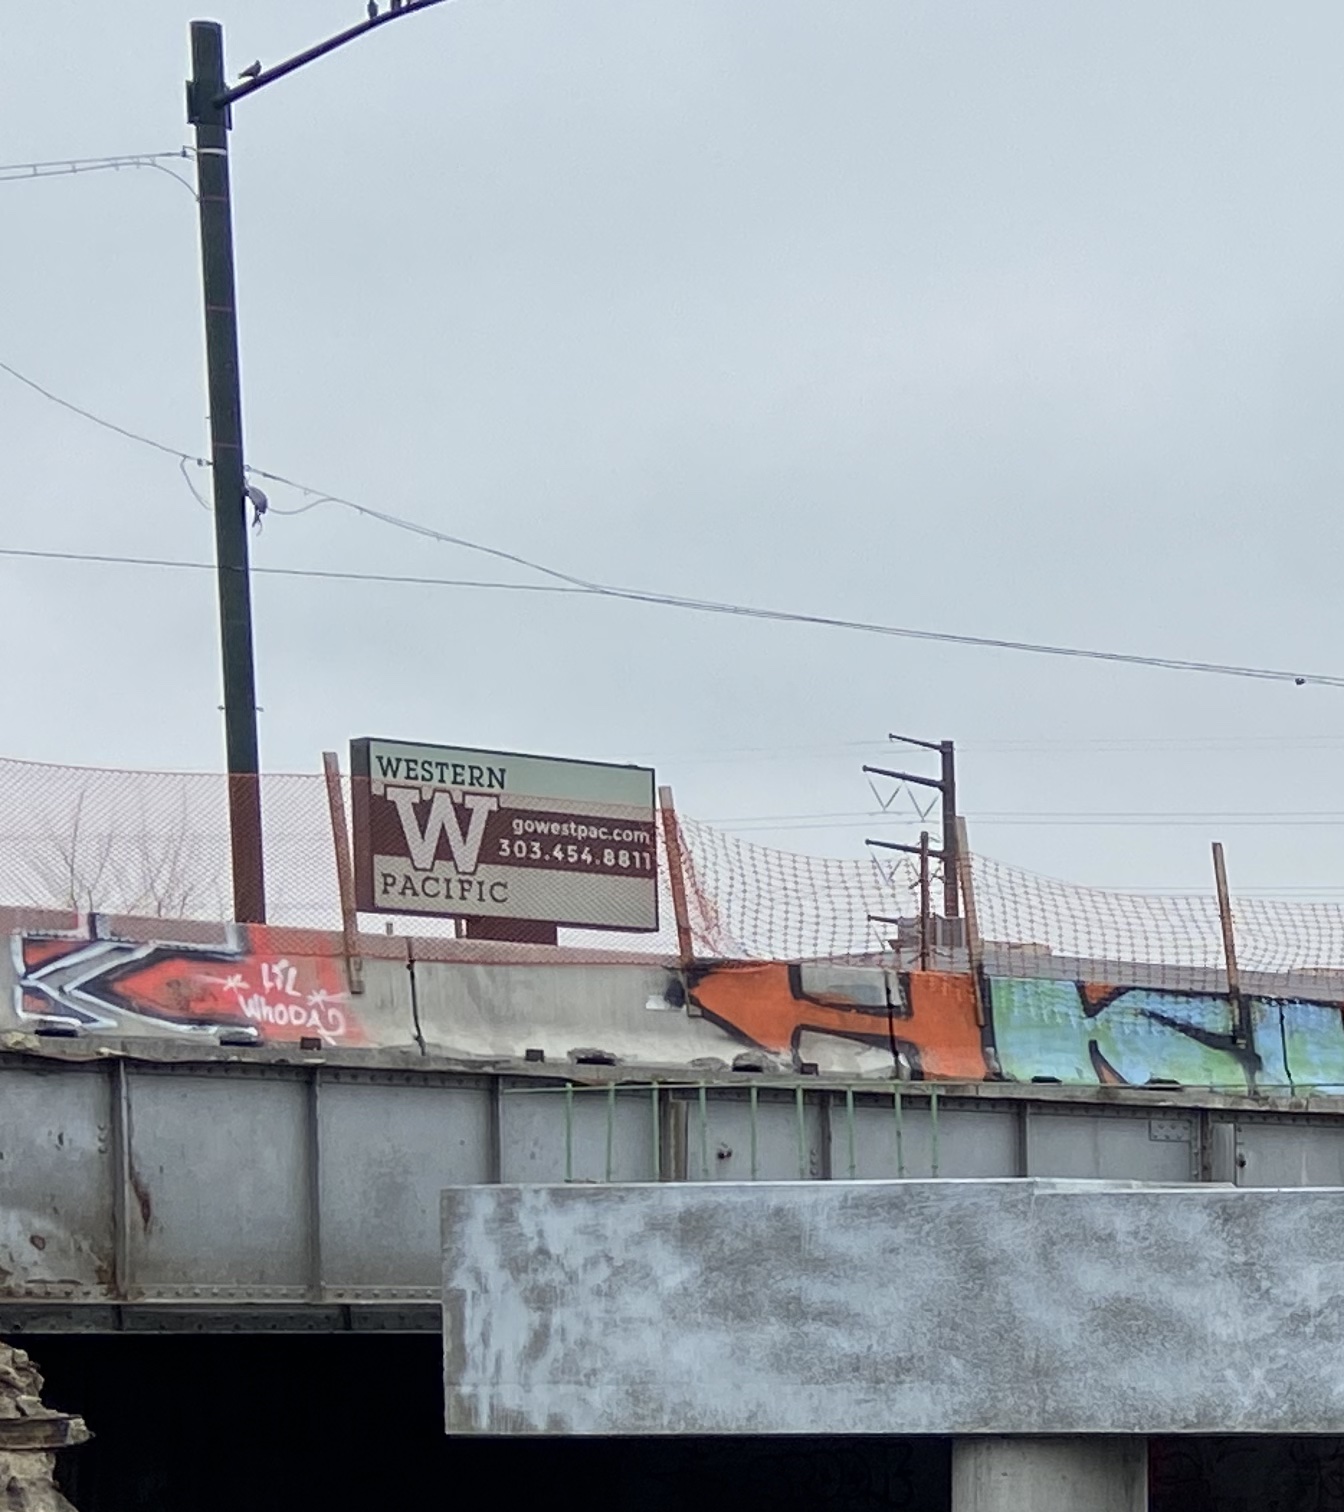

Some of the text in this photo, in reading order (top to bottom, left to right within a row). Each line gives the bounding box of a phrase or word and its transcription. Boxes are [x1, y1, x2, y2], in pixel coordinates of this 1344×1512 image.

[376, 756, 507, 790] WESTERN
[384, 784, 501, 875] W
[511, 816, 650, 845] gowestpac.com
[499, 838, 650, 871] 303.454.8811
[381, 872, 509, 903] PACIFIC
